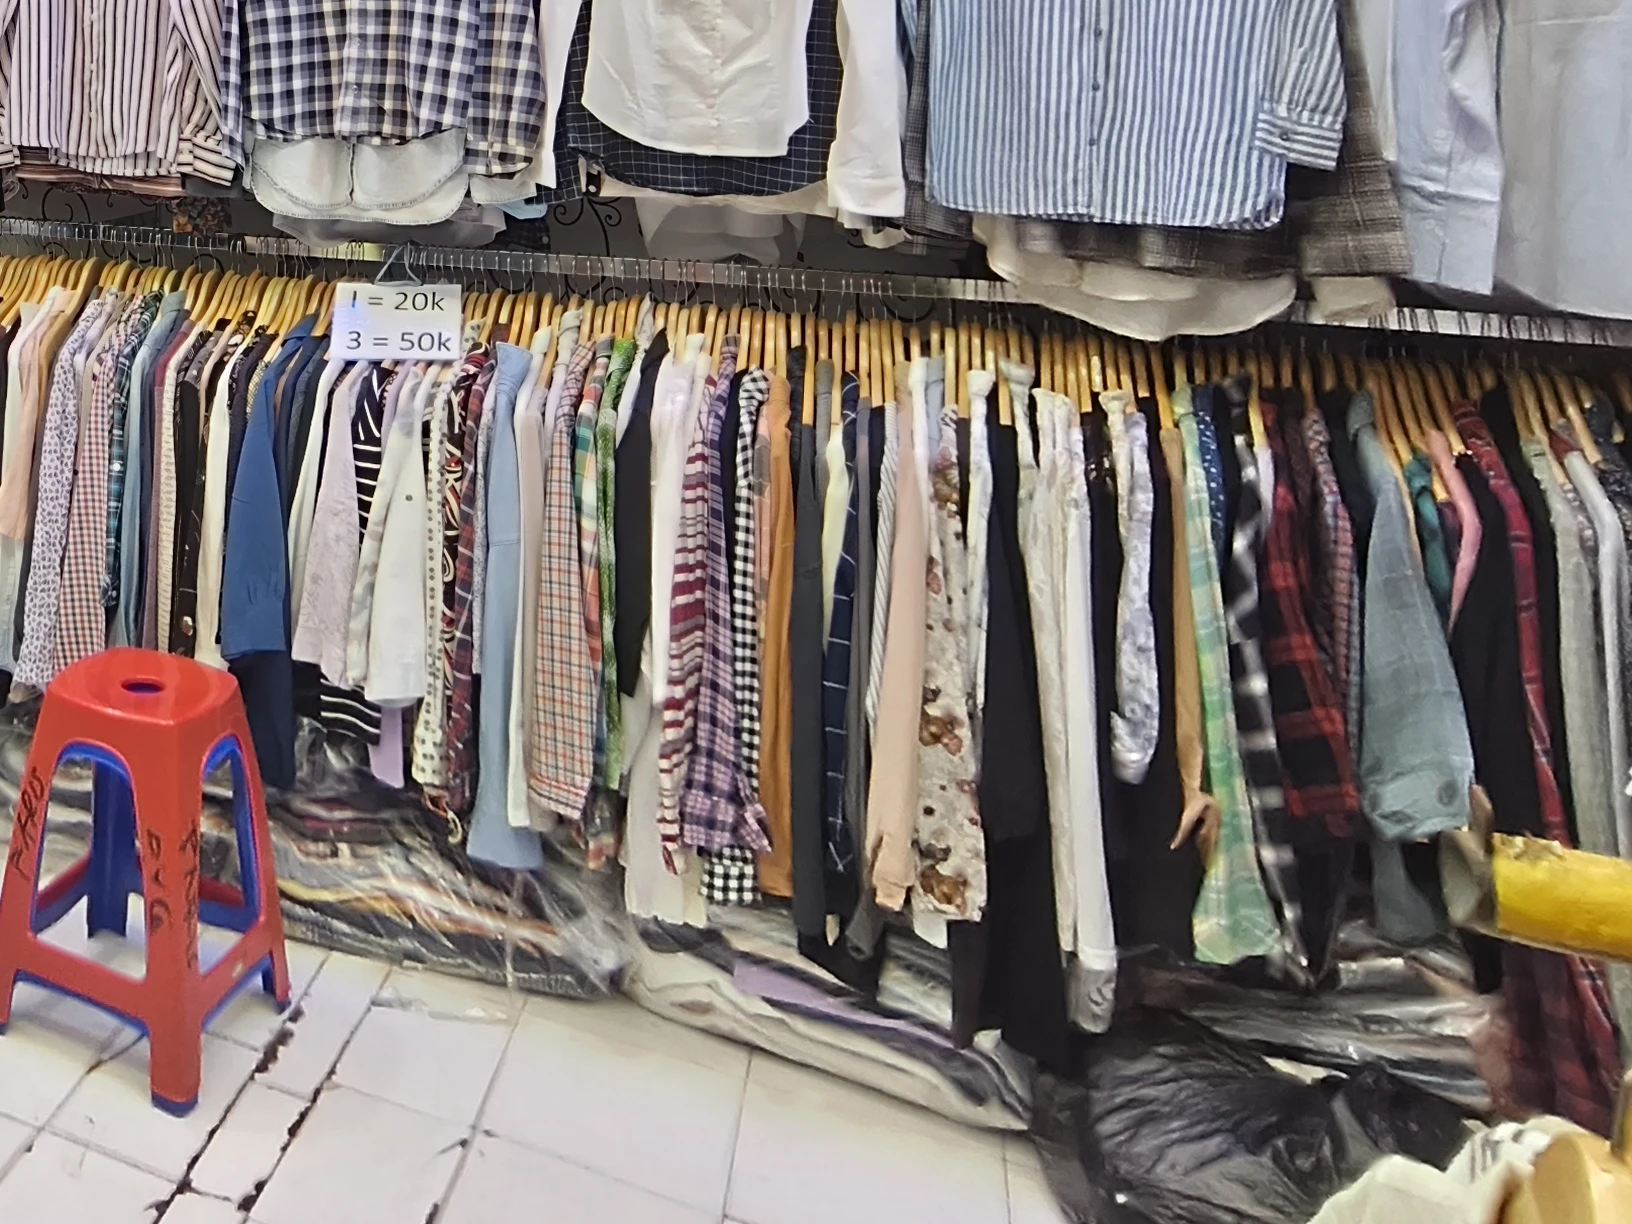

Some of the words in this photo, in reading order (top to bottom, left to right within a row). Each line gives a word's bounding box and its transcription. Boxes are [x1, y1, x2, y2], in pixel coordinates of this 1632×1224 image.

[394, 291, 445, 311] 20k
[346, 331, 362, 350] 3
[399, 331, 452, 352] 50k
